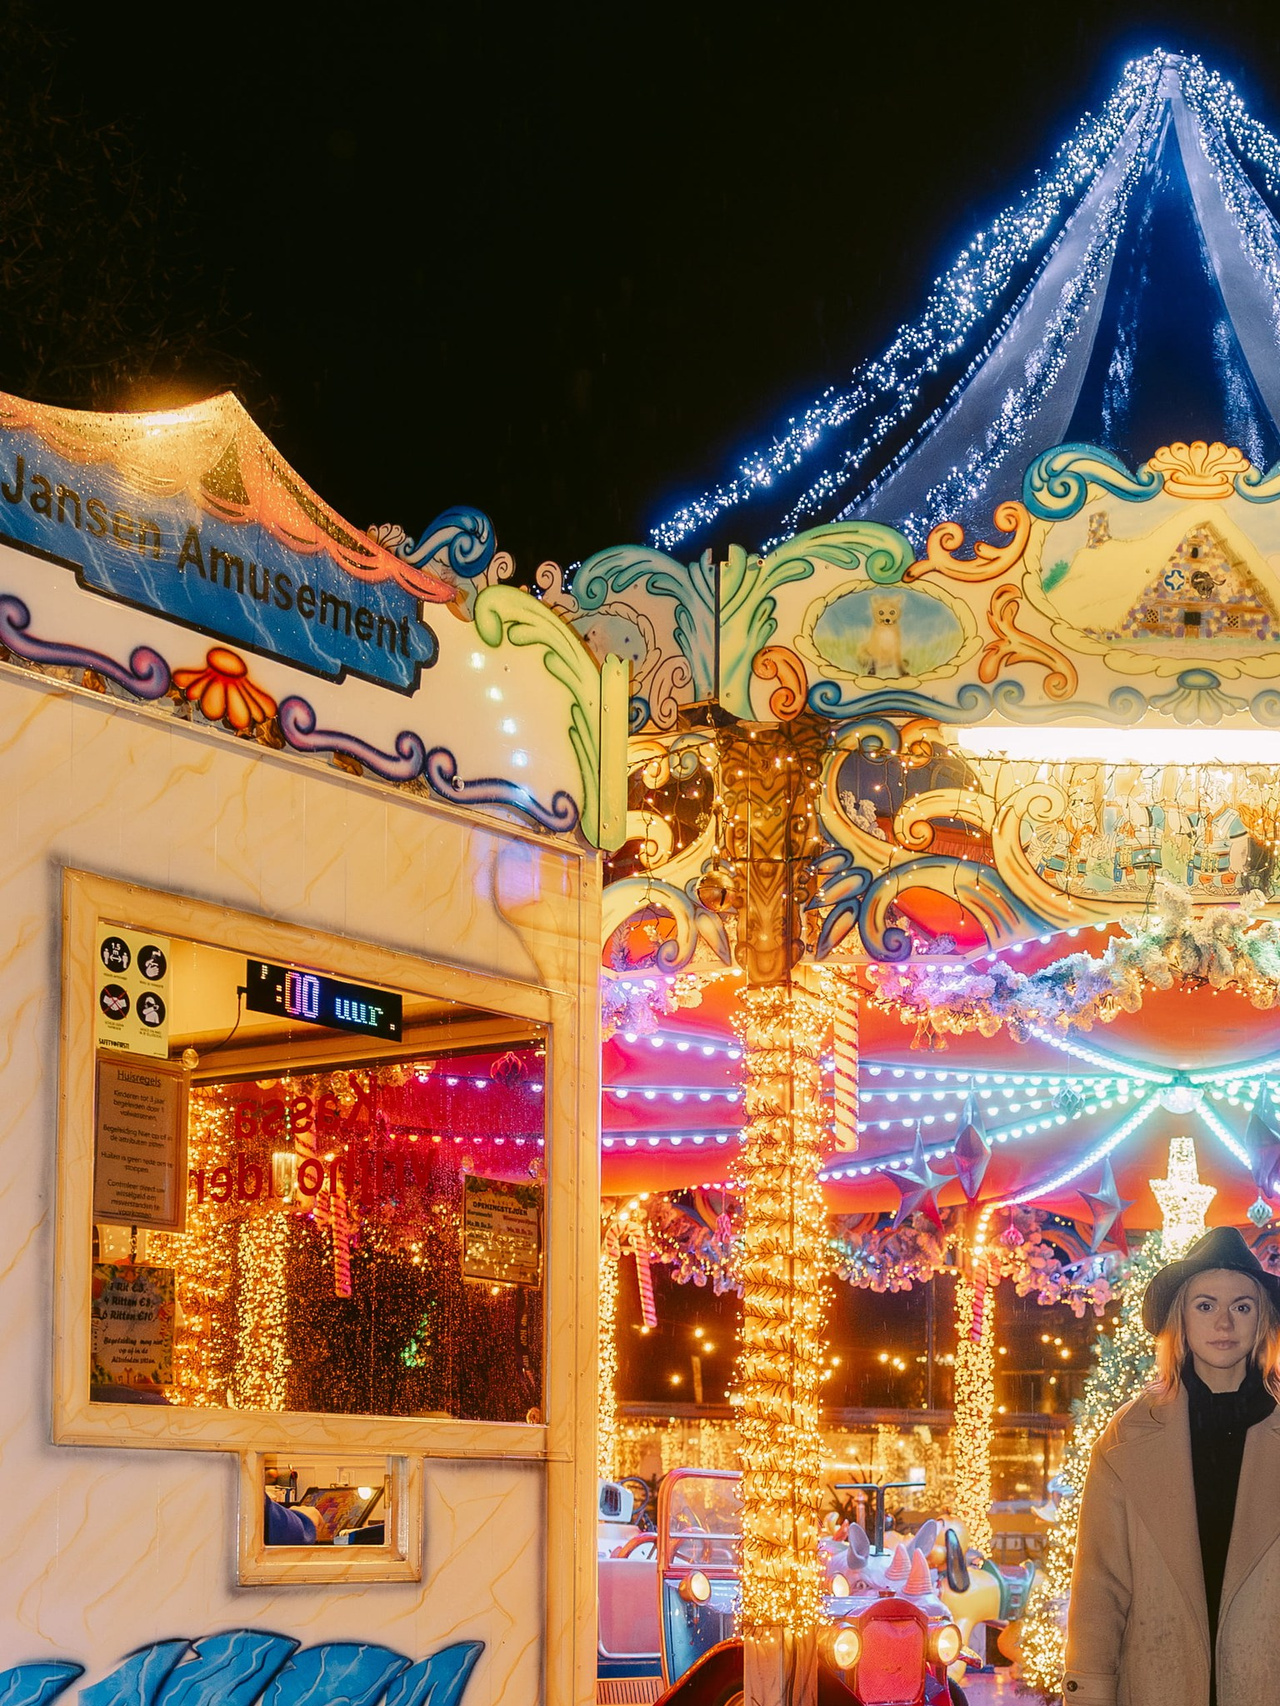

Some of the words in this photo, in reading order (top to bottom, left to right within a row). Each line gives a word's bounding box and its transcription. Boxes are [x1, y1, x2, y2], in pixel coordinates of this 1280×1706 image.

[1, 454, 162, 559] Jansen
[176, 526, 411, 659] Amusement
[335, 998, 384, 1027] uur
[117, 1069, 161, 1087] Huisregels
[117, 1282, 129, 1292] Rit
[112, 1295, 137, 1306] Ritten
[110, 1310, 136, 1320] Ritten
